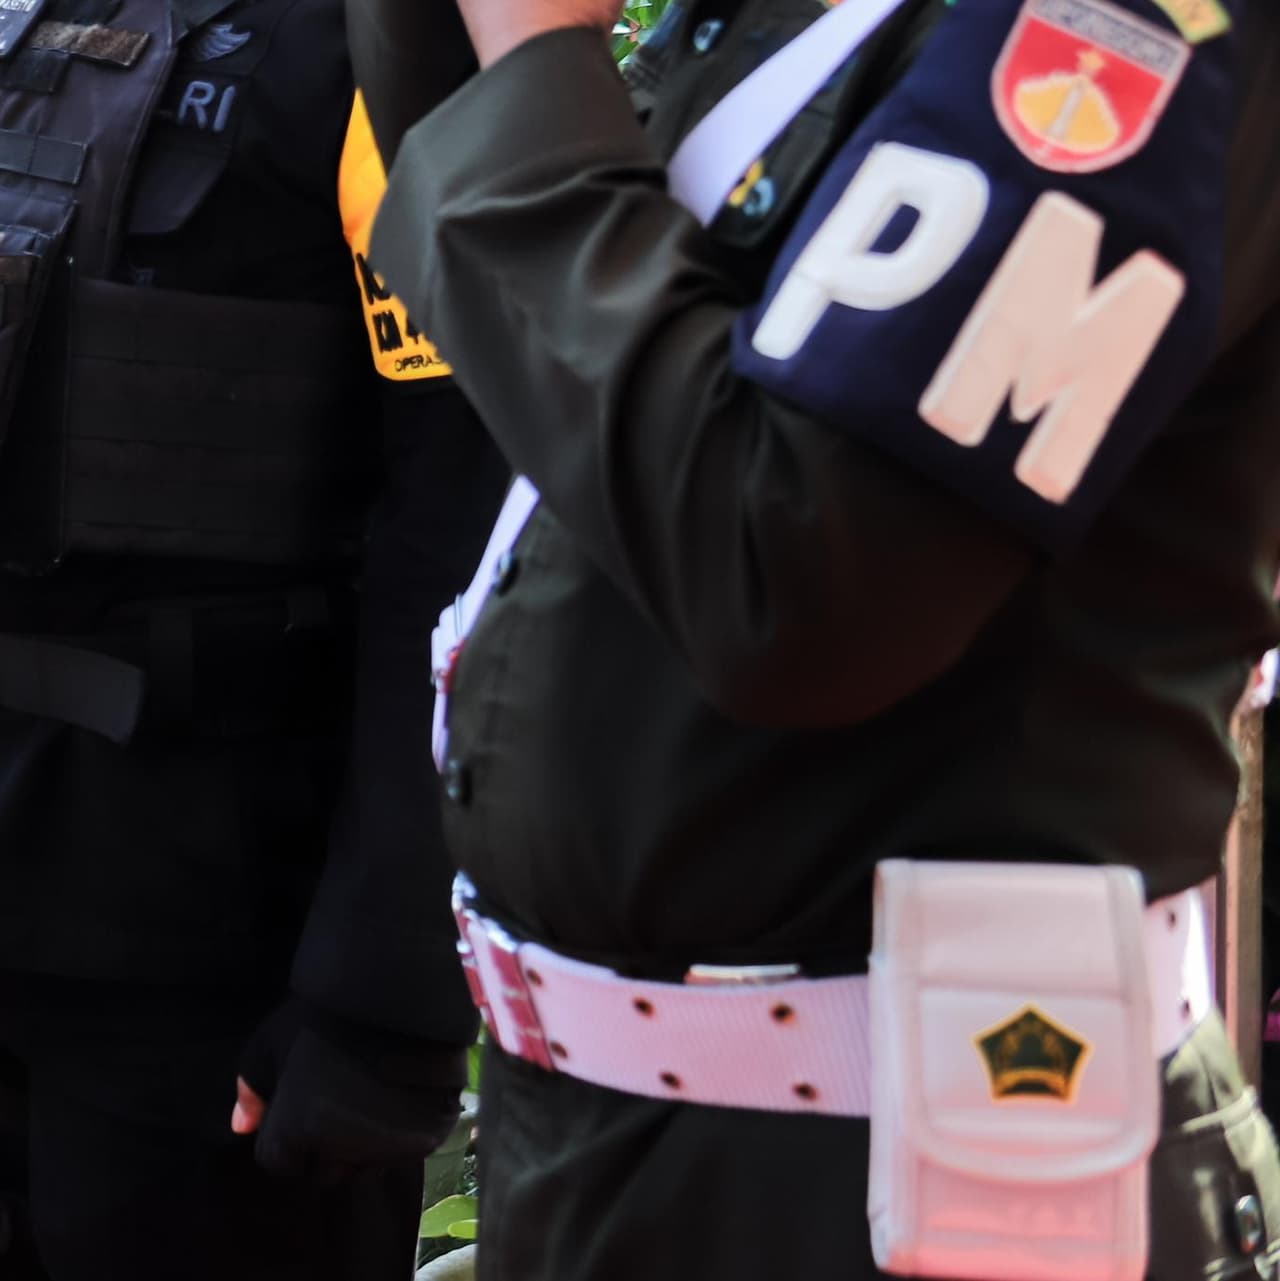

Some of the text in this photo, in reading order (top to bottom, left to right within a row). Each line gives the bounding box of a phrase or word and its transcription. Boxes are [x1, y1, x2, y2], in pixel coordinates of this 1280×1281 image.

[178, 80, 236, 132] RI
[751, 141, 1186, 505] PM
[394, 354, 441, 372] OPERA
